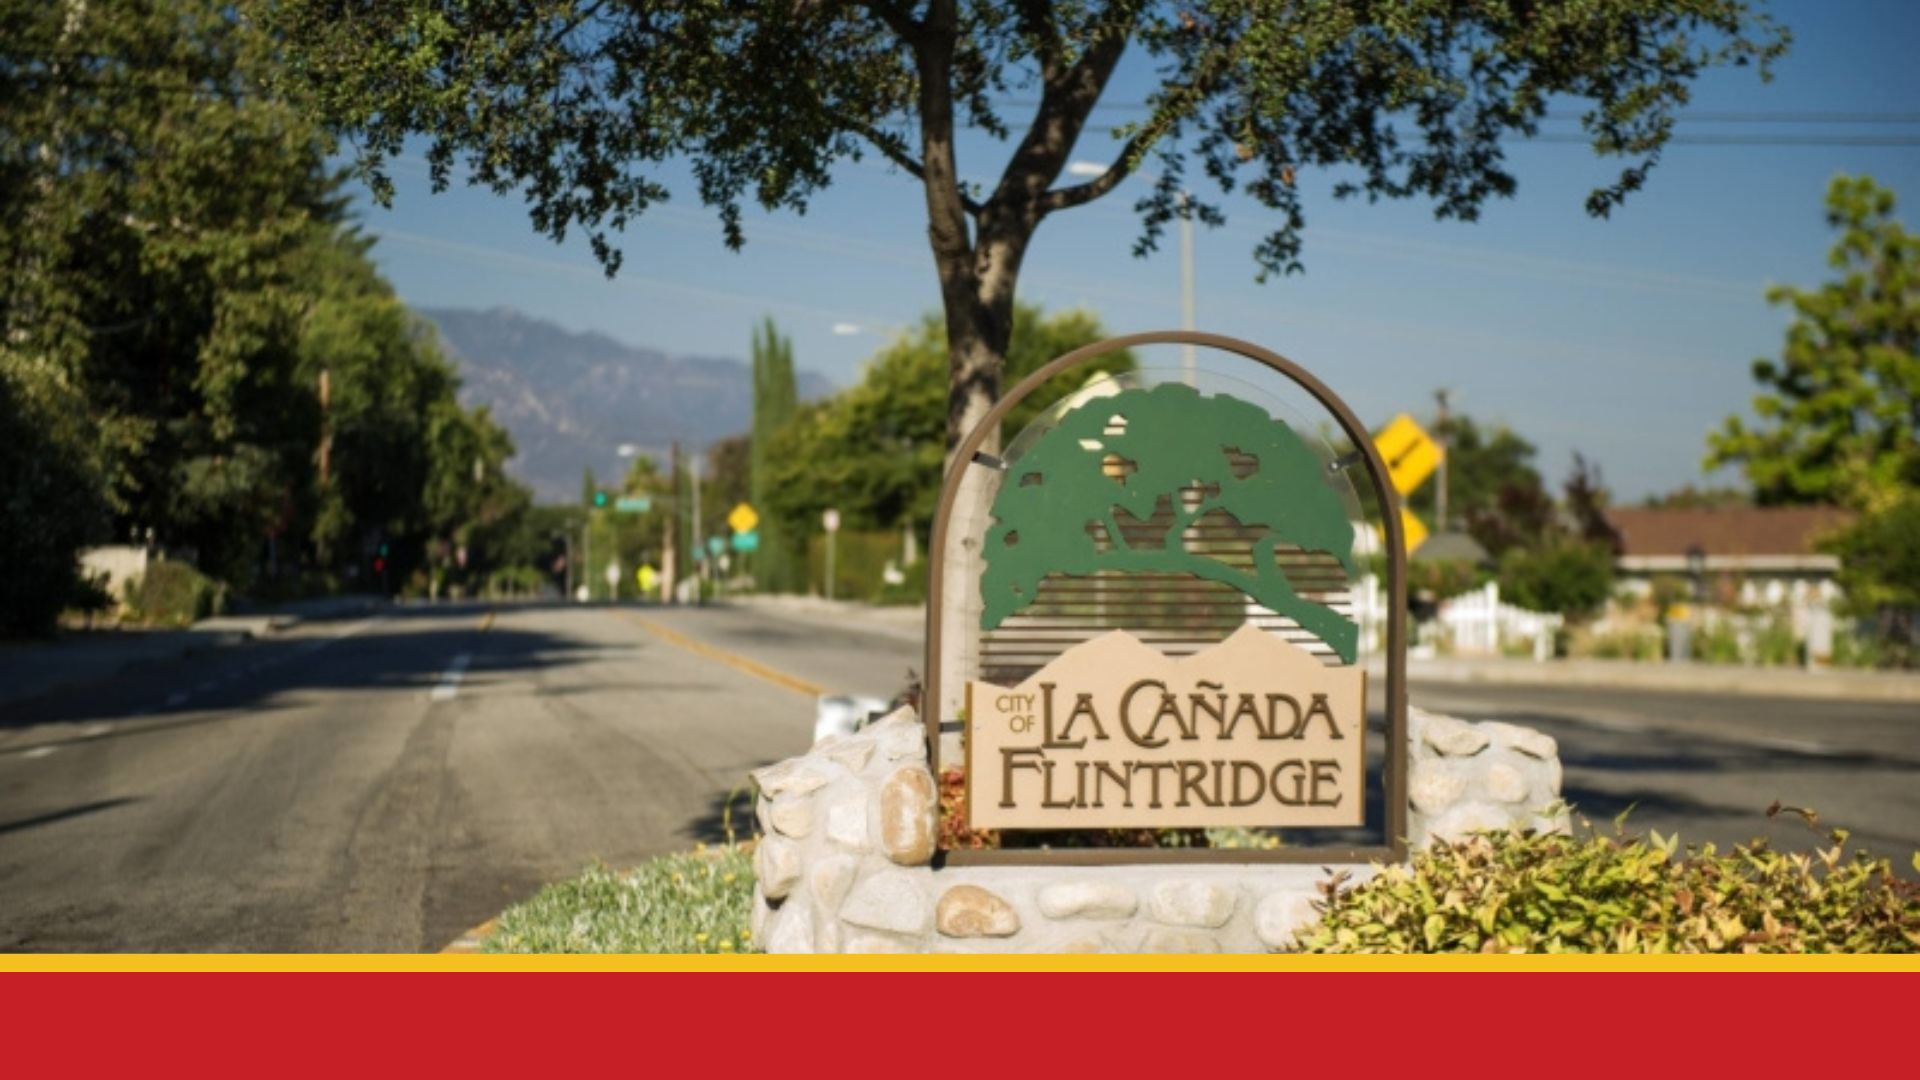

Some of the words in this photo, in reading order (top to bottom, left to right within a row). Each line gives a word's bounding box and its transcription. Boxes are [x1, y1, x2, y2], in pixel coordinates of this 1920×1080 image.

[995, 694, 1036, 714] CITY
[1009, 715, 1036, 733] OF
[1039, 682, 1110, 750] LA
[1119, 679, 1344, 749] CAÑADA
[998, 746, 1343, 809] FLINTRIDGE
